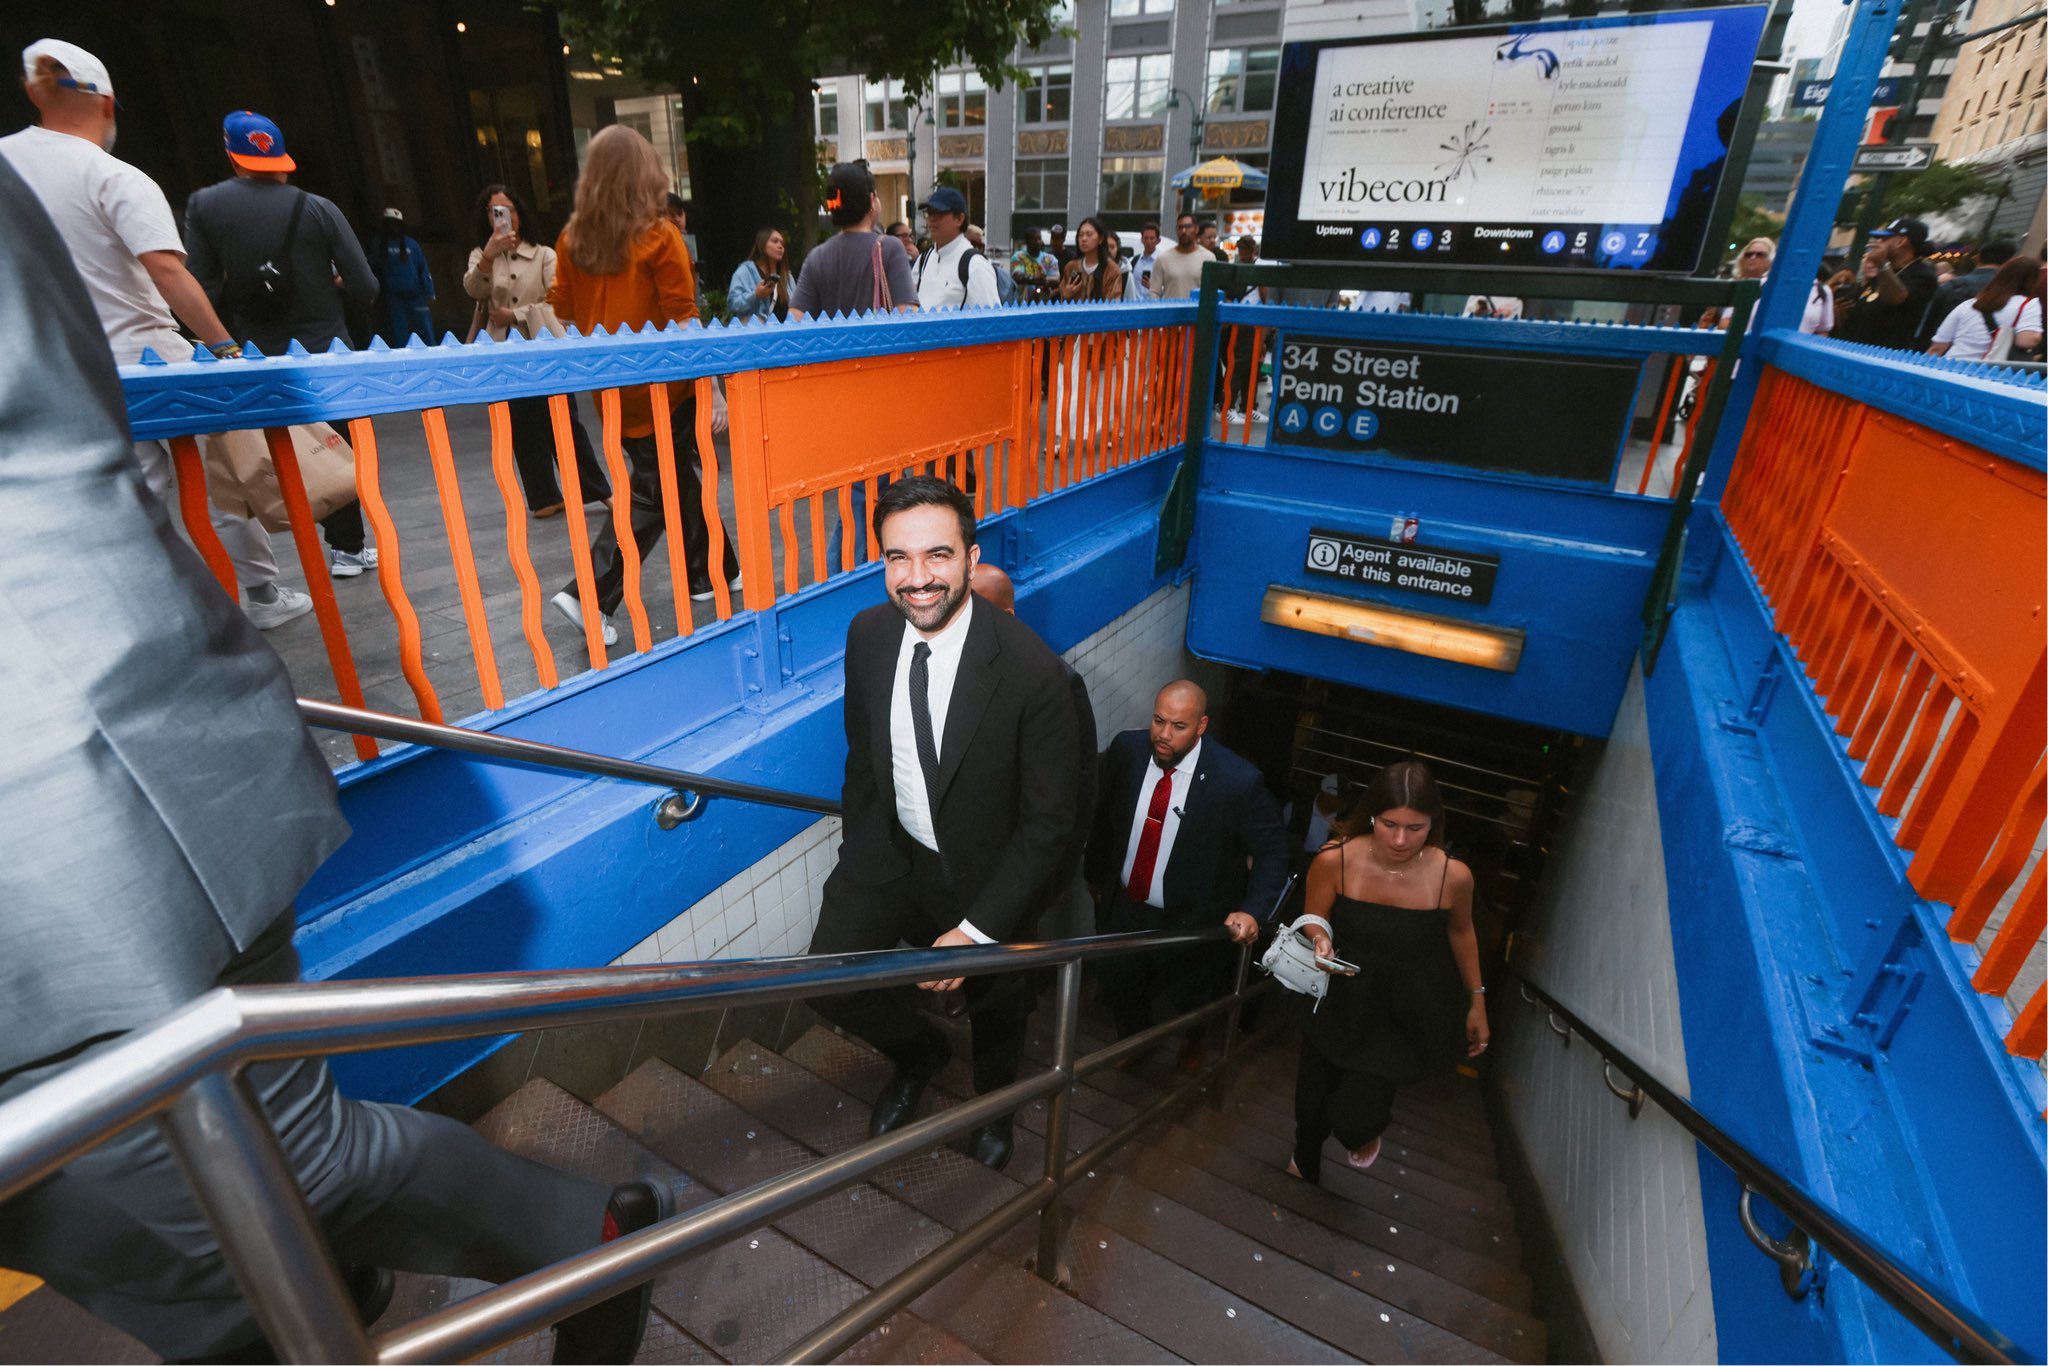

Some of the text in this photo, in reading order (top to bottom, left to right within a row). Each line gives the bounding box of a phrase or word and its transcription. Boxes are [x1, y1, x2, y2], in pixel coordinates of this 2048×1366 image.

[1332, 75, 1414, 97] a creative
[1558, 75, 1628, 94] kyle mcdonald
[1329, 98, 1447, 122] ai conference
[1582, 99, 1602, 112] kim
[1320, 166, 1447, 203] vibecon
[1316, 225, 1353, 237] Uptown
[1365, 229, 1400, 246] A 2
[1417, 229, 1452, 246] E 3
[1474, 227, 1534, 239] Downtown
[1547, 232, 1588, 249] A 5
[1606, 233, 1650, 250] C 7
[1283, 345, 1421, 380] 34 Street
[1279, 374, 1460, 414] Penn Station
[1285, 409, 1371, 435] A C E
[1342, 544, 1472, 578] Agent available
[1339, 563, 1473, 597] at this entrance
